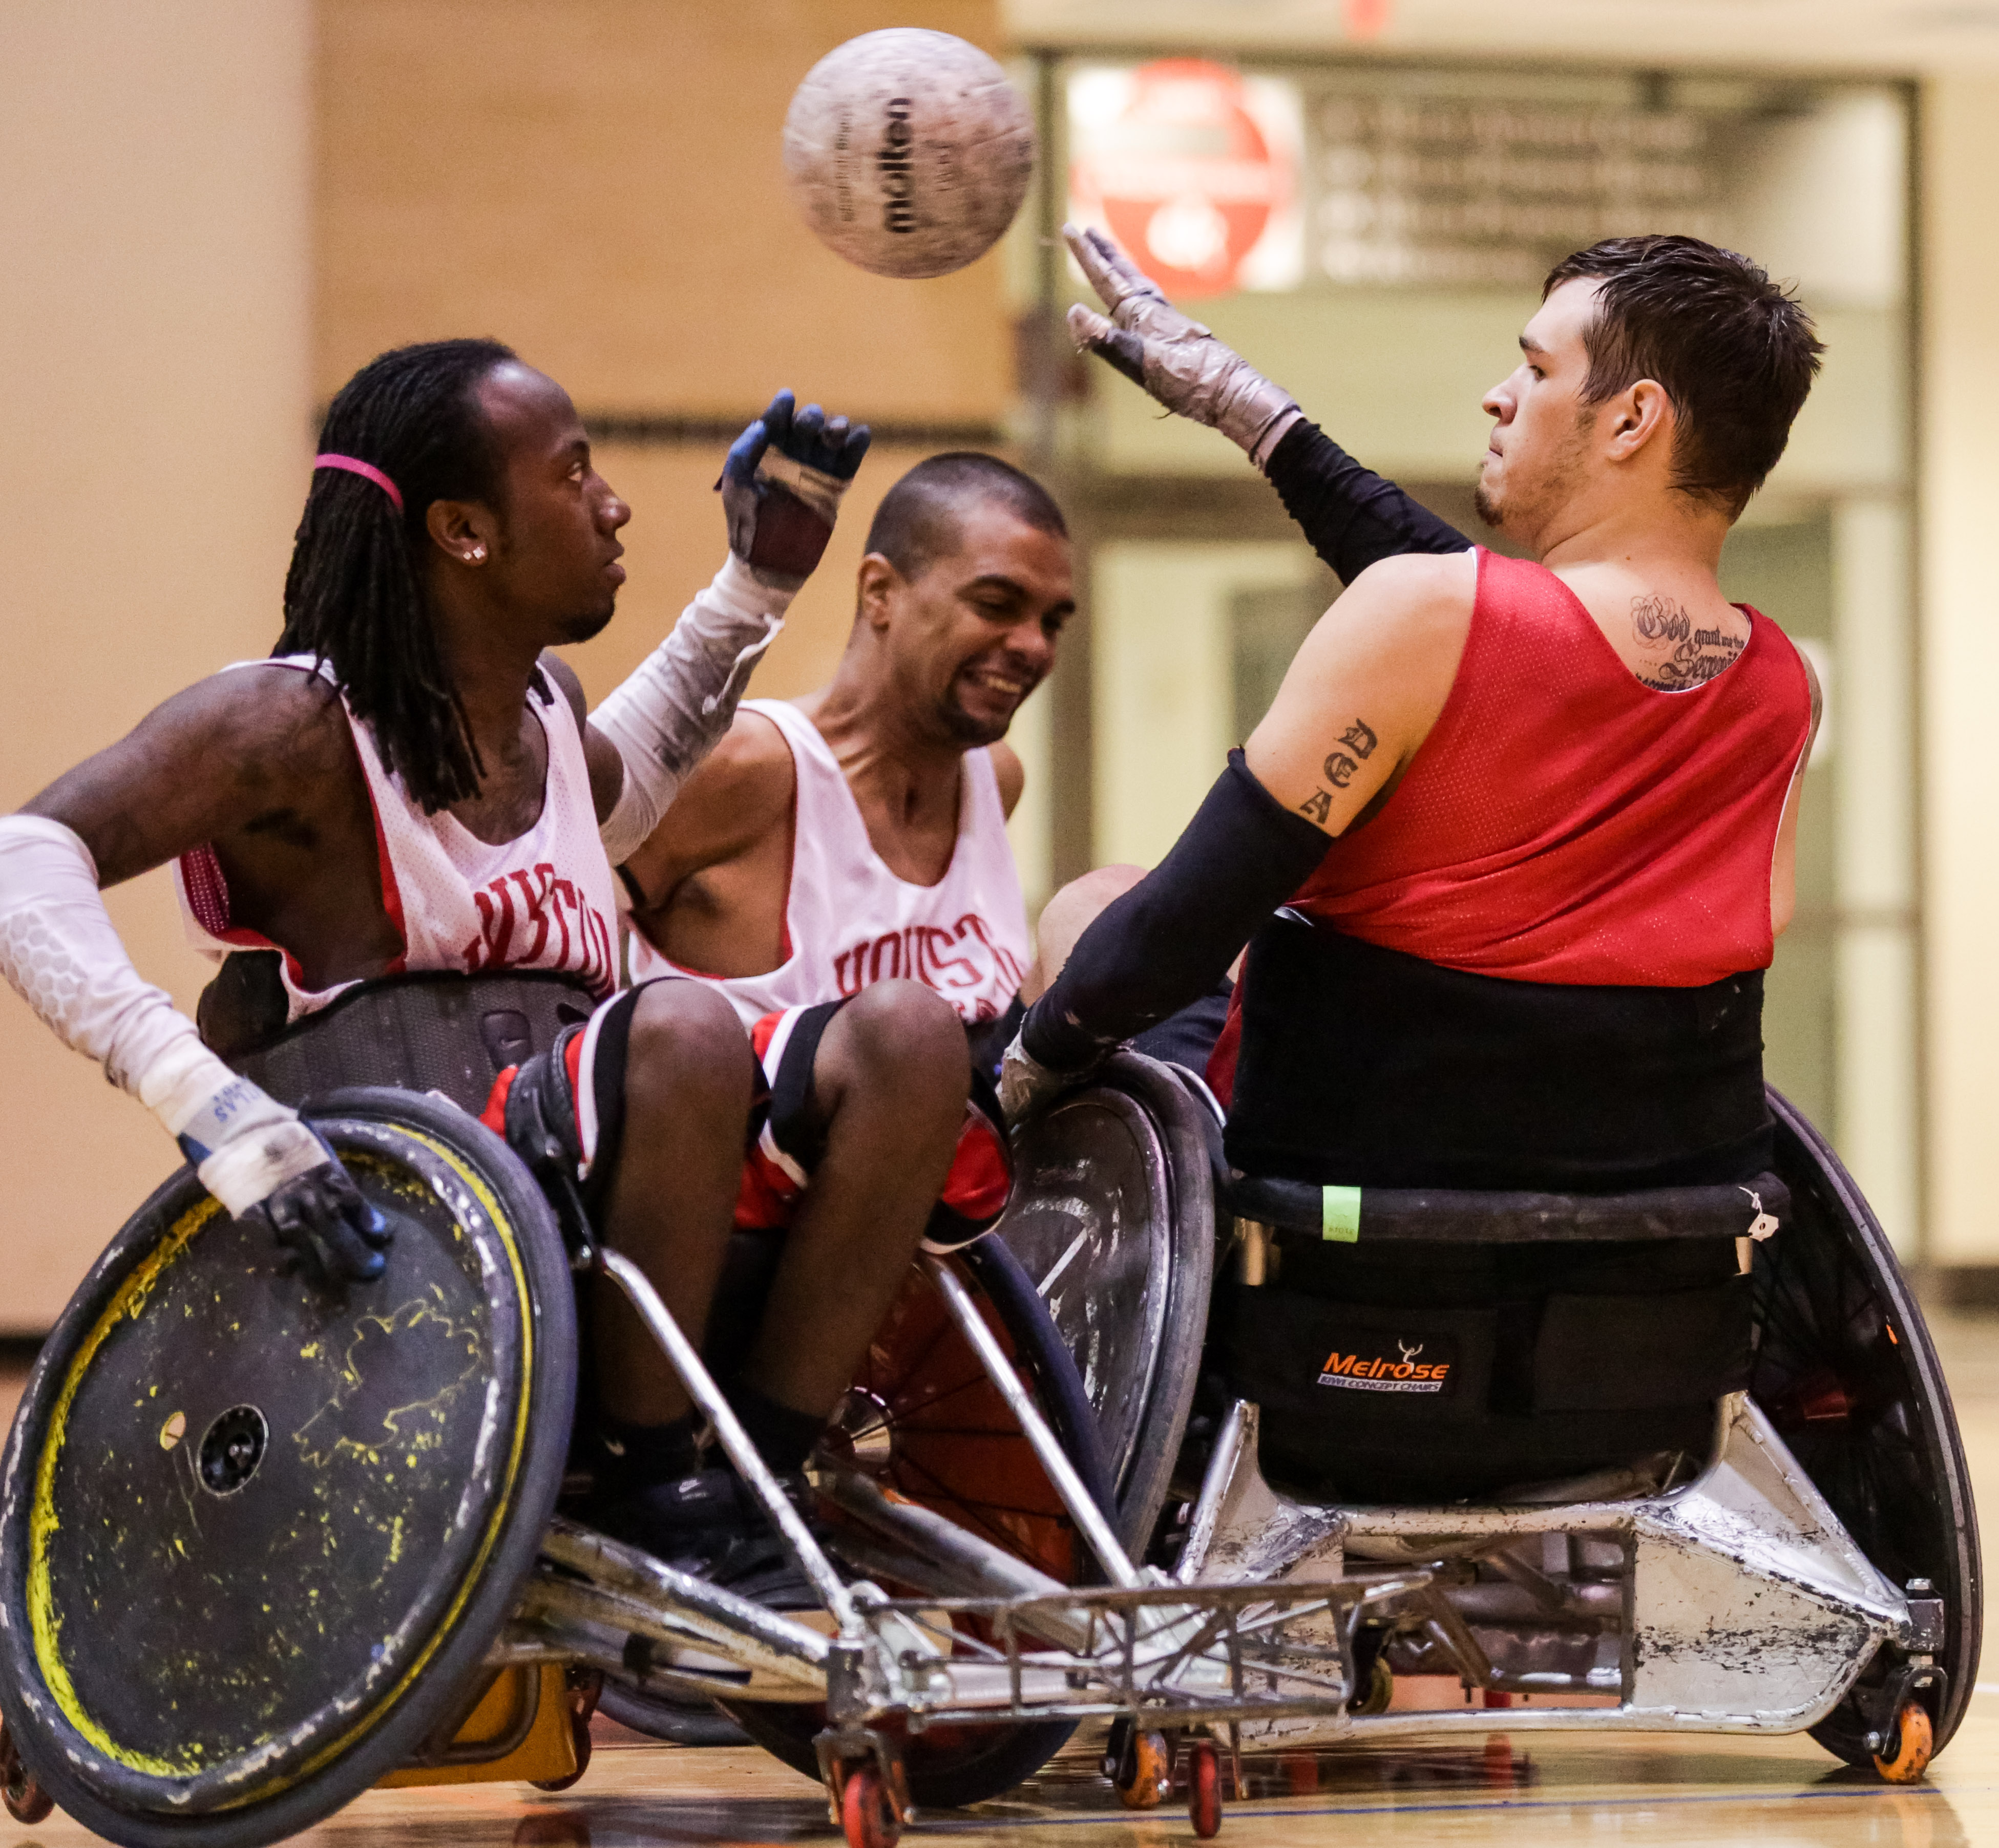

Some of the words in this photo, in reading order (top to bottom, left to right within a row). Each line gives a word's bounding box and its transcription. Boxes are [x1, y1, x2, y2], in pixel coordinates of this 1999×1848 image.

[874, 98, 914, 233] molten
[1636, 596, 1690, 642] God
[1694, 626, 1721, 654] grant
[1322, 1352, 1450, 1379] Melrose
[1348, 1380, 1400, 1391] CONCEPT
[1401, 1383, 1439, 1391] CHAIRS
